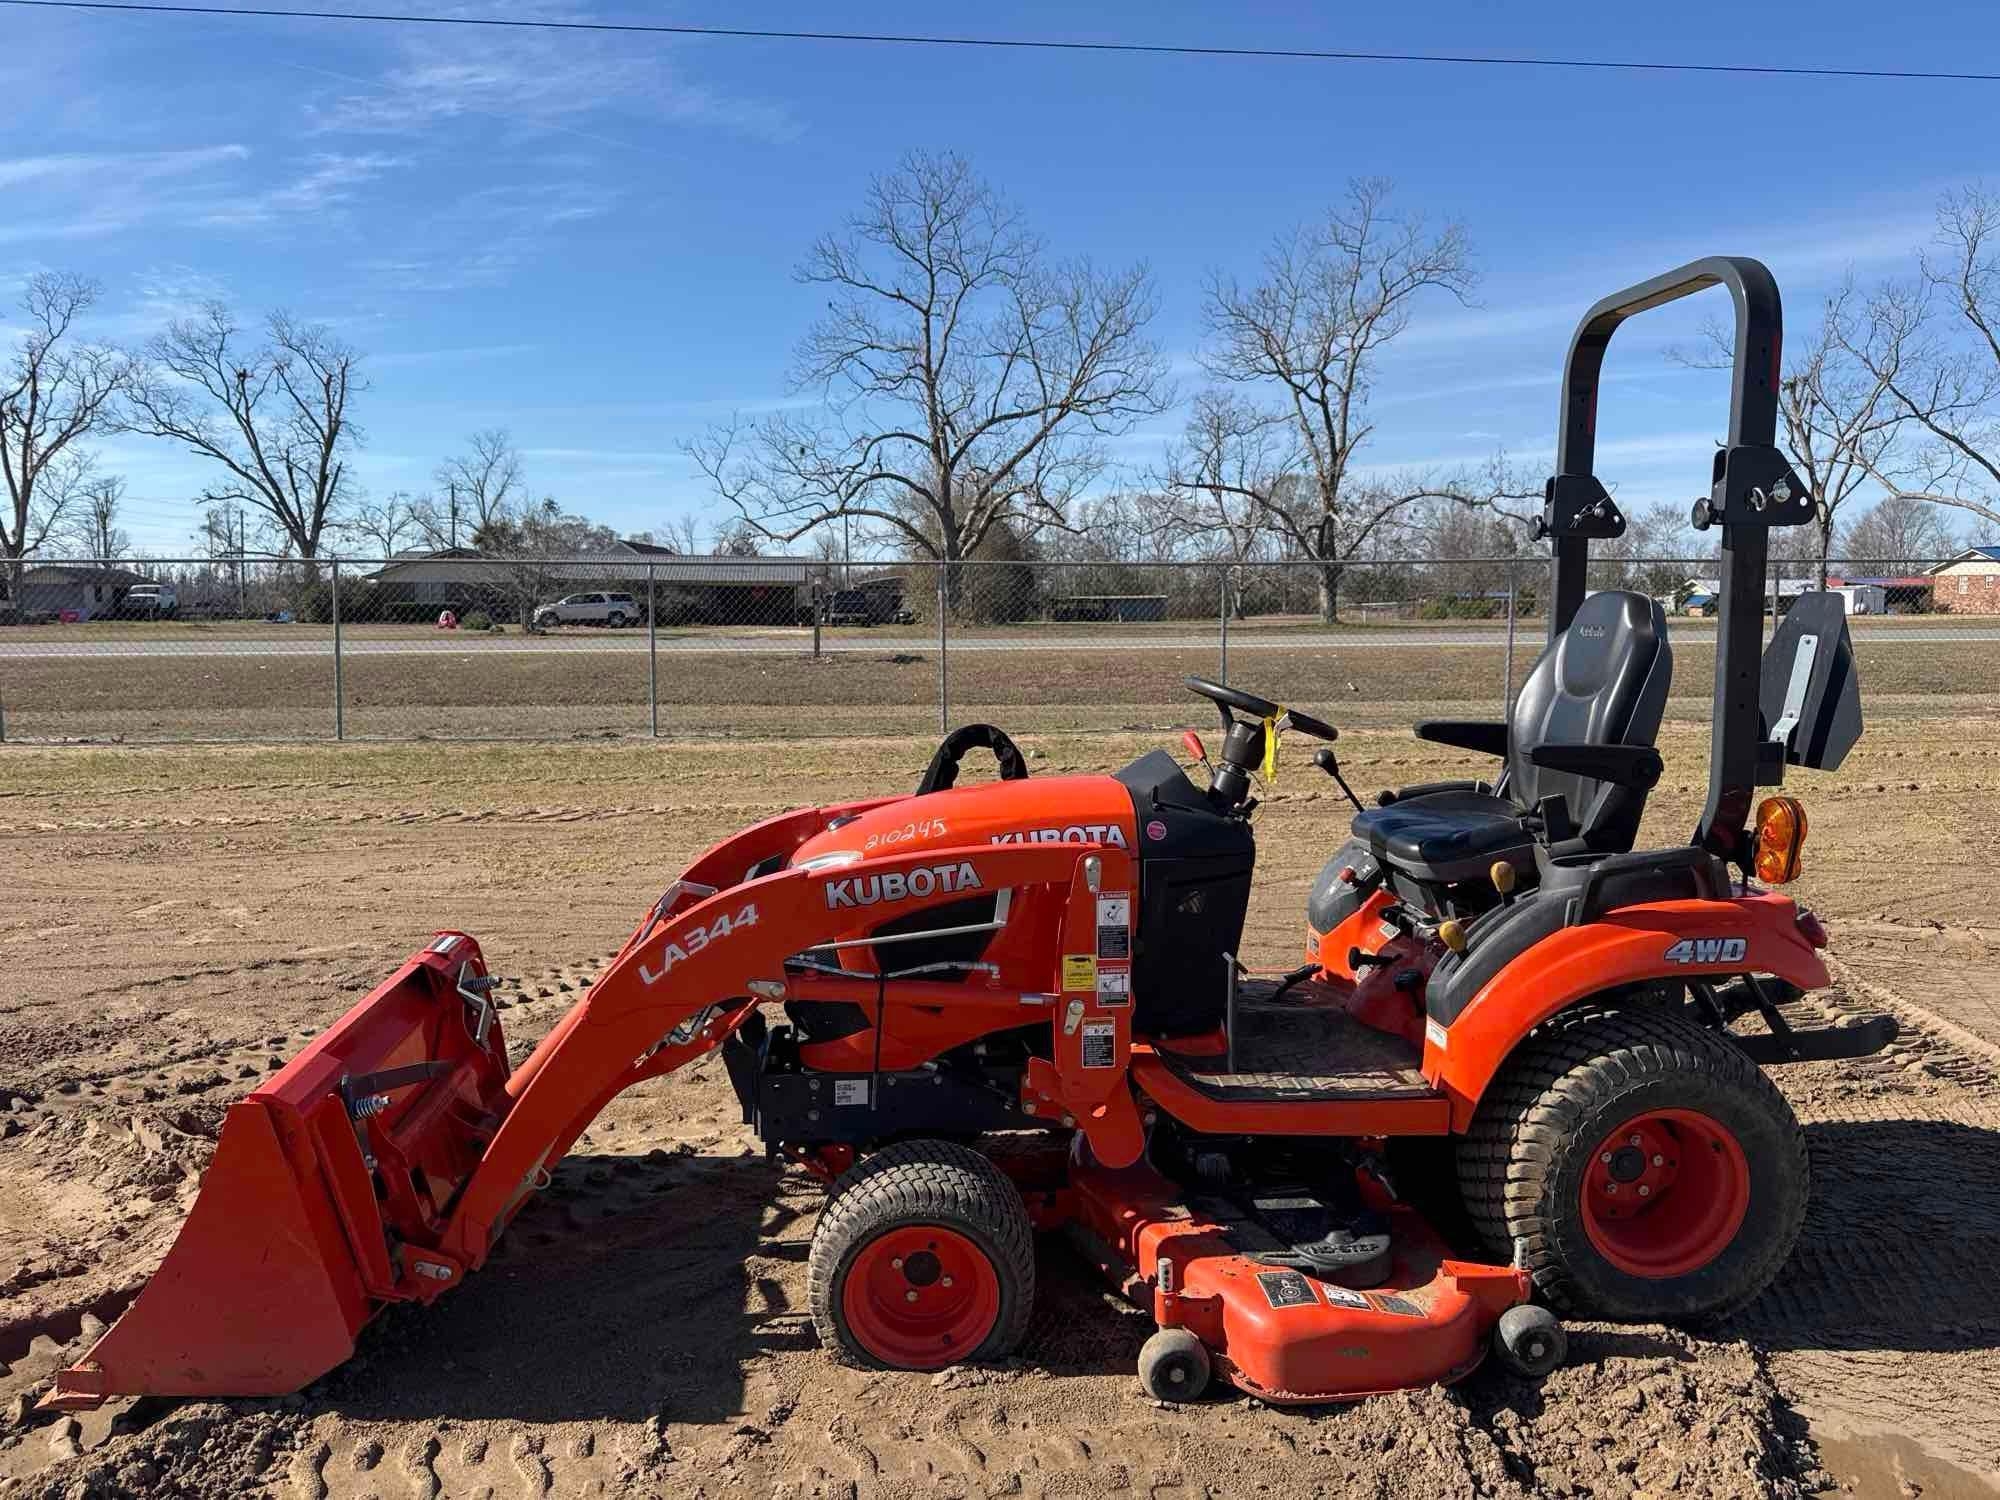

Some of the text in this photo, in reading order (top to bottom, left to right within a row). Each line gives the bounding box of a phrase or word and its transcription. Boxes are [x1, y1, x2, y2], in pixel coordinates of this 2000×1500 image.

[865, 818, 947, 849] 210245
[825, 862, 982, 909] KUBOTA
[638, 903, 759, 985] LA344
[1664, 938, 1747, 963] 4WD
